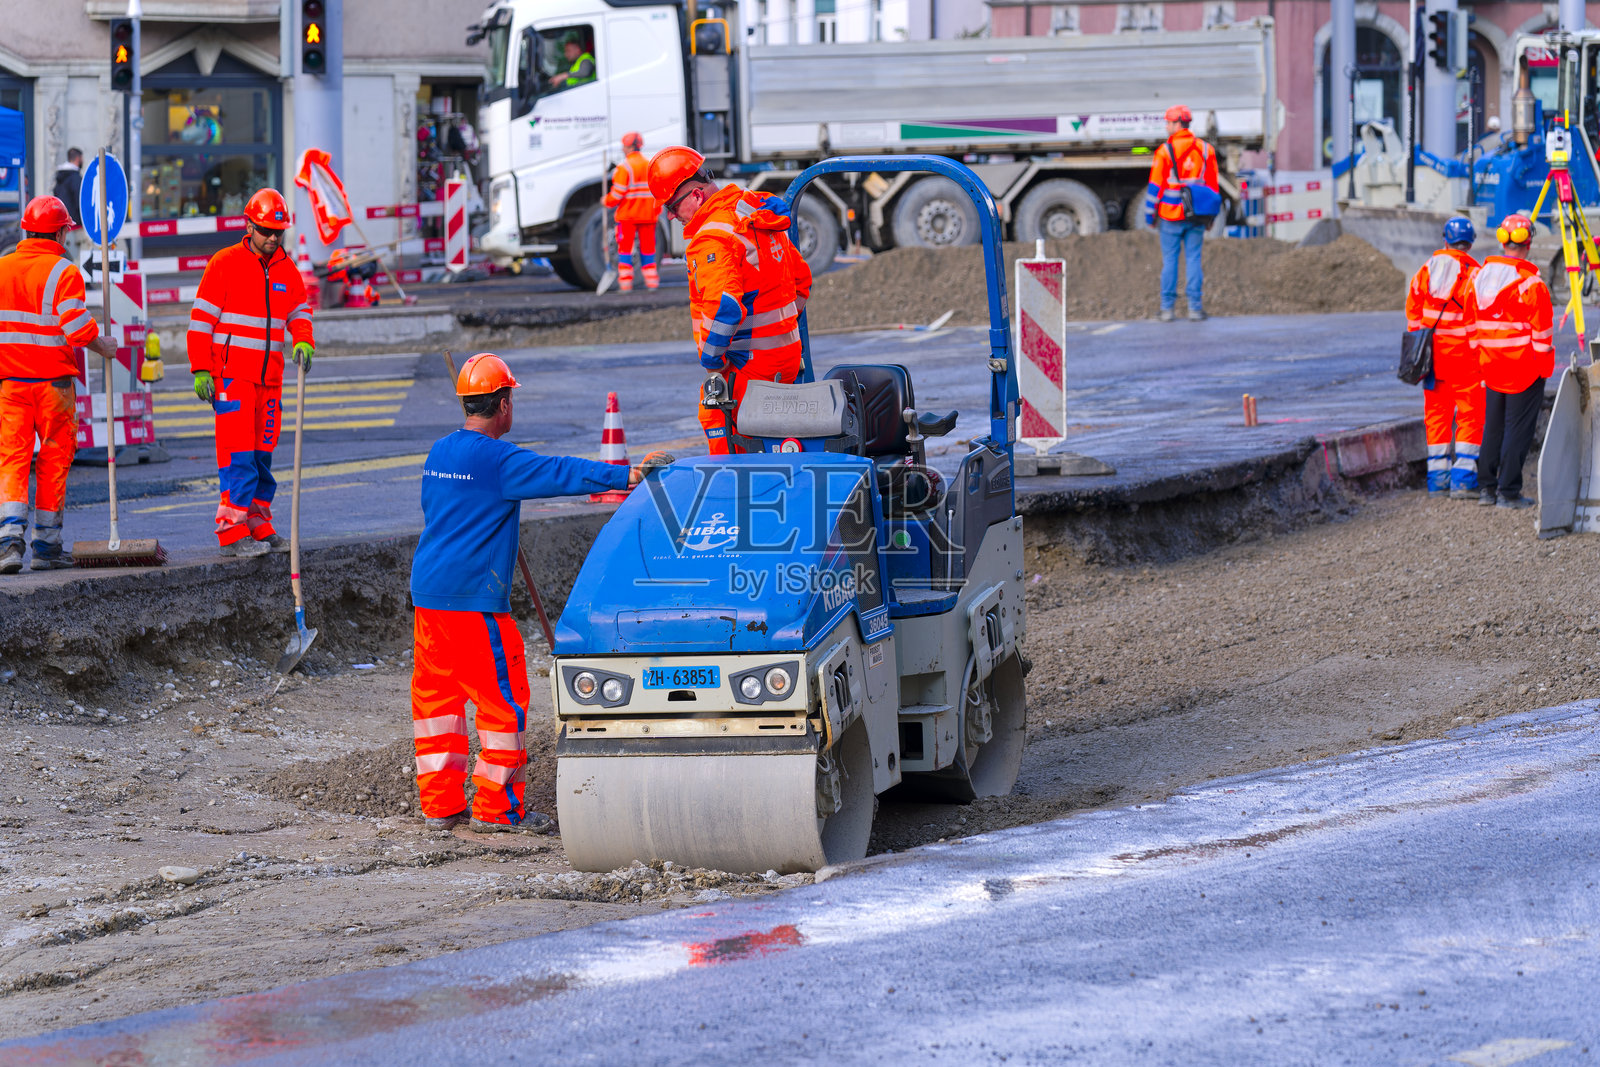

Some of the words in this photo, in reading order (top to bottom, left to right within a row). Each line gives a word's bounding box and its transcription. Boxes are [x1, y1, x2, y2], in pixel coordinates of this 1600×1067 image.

[263, 398, 277, 444] KIBAG
[679, 526, 740, 537] KIBAG
[823, 577, 856, 613] KIBAG
[869, 612, 889, 634] 36045
[649, 670, 664, 686] ZH
[673, 669, 716, 686] 63851
